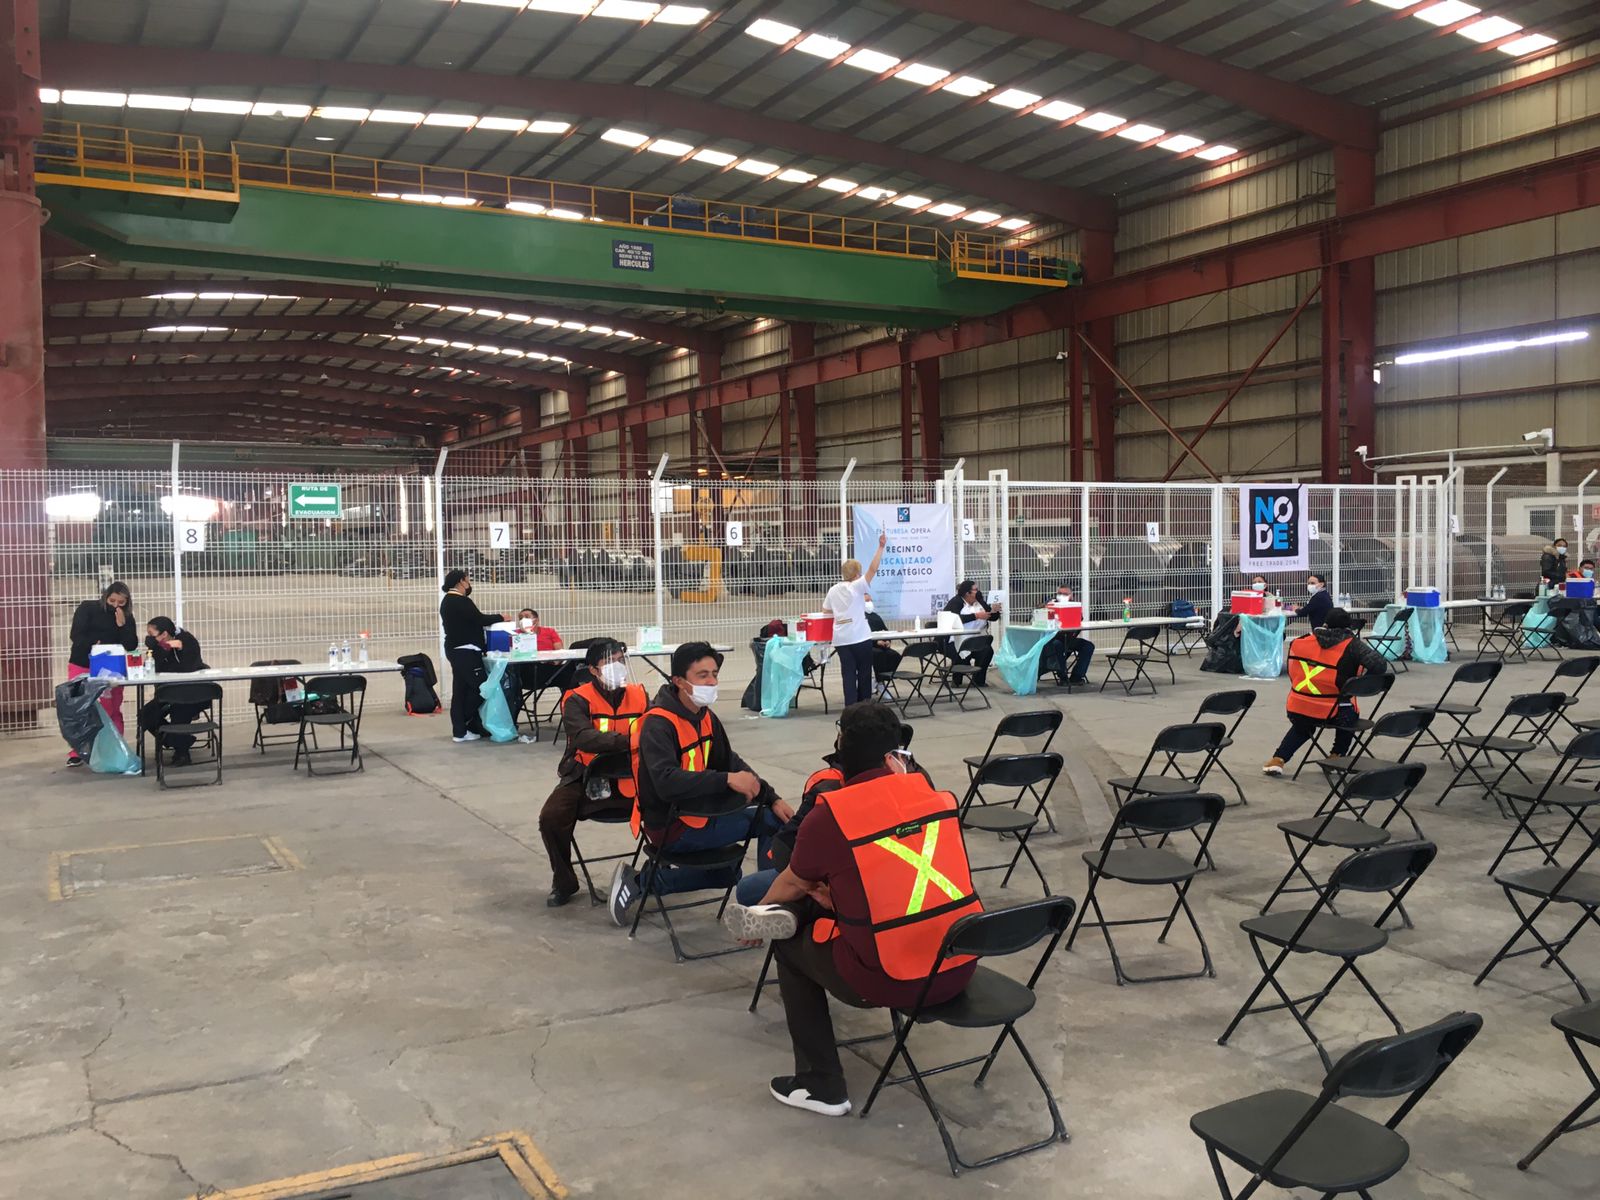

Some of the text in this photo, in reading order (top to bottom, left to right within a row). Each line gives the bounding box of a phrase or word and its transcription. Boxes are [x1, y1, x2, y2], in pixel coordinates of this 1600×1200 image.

[619, 259, 650, 269] HERCULES
[1255, 496, 1293, 524] NO
[186, 528, 198, 544] 8
[494, 528, 504, 542] 7
[730, 526, 738, 540] 6
[910, 527, 932, 535] OPERA
[963, 524, 970, 538] 5
[1149, 527, 1156, 538] 4
[1312, 525, 1317, 535] 3
[1255, 523, 1289, 550] DE
[886, 545, 923, 553] RECINTO
[880, 556, 933, 565] ISCALIZADO
